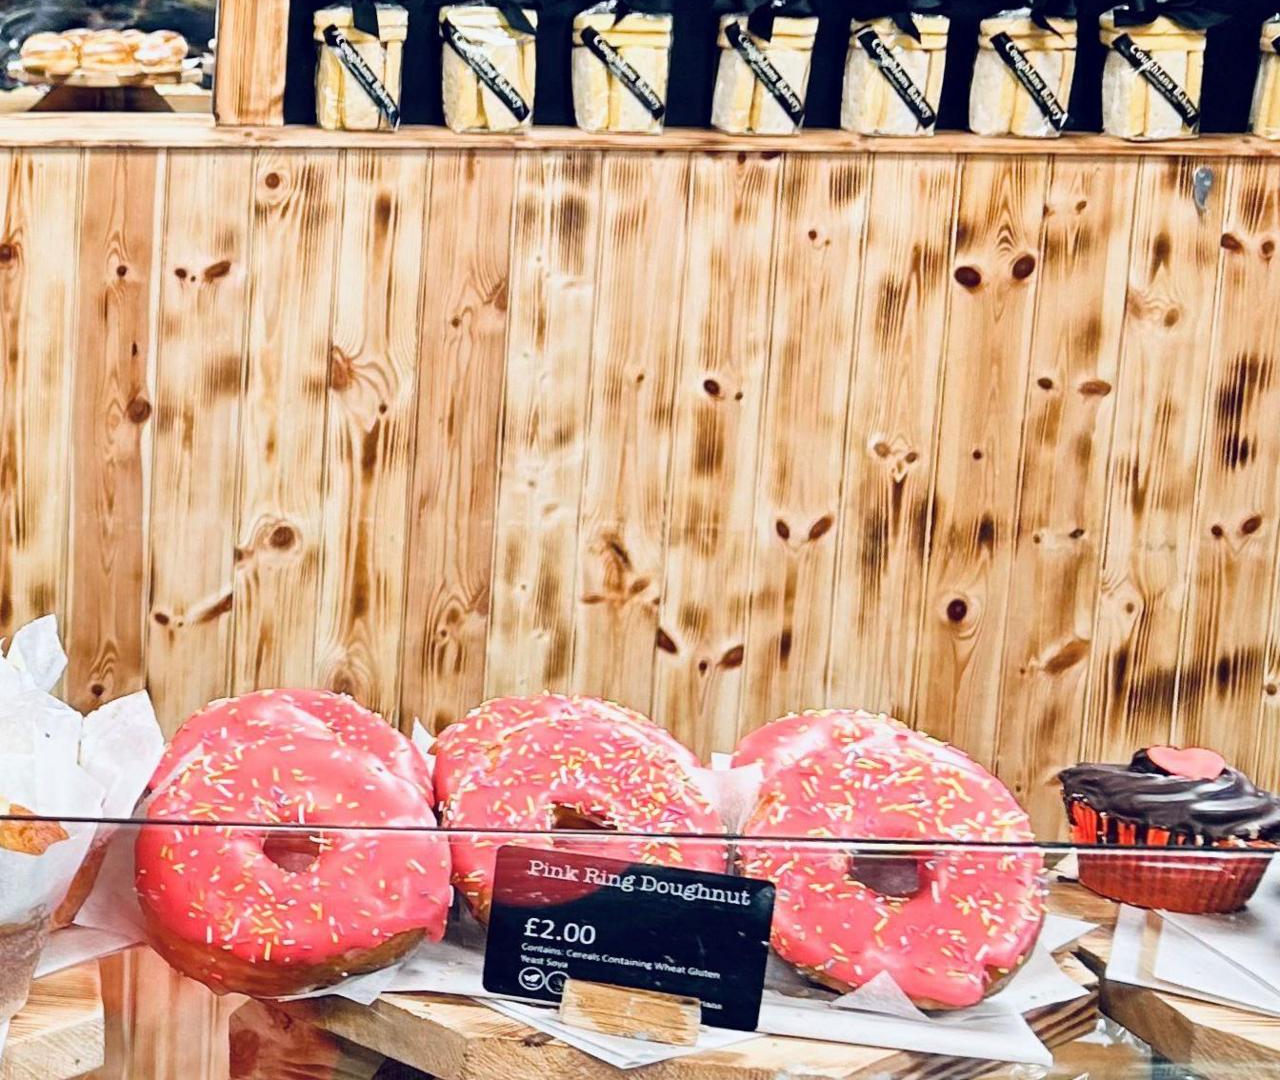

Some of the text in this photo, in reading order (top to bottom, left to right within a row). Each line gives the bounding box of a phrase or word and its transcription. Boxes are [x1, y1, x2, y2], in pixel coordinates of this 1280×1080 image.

[1005, 41, 1044, 90] Coughlans
[528, 860, 751, 906] Pink Ring Doughnut
[524, 918, 596, 945] £2.00
[520, 954, 569, 970] Yeast Soya
[521, 942, 721, 980] Contains: Cereals Containing Wheat Gluten
